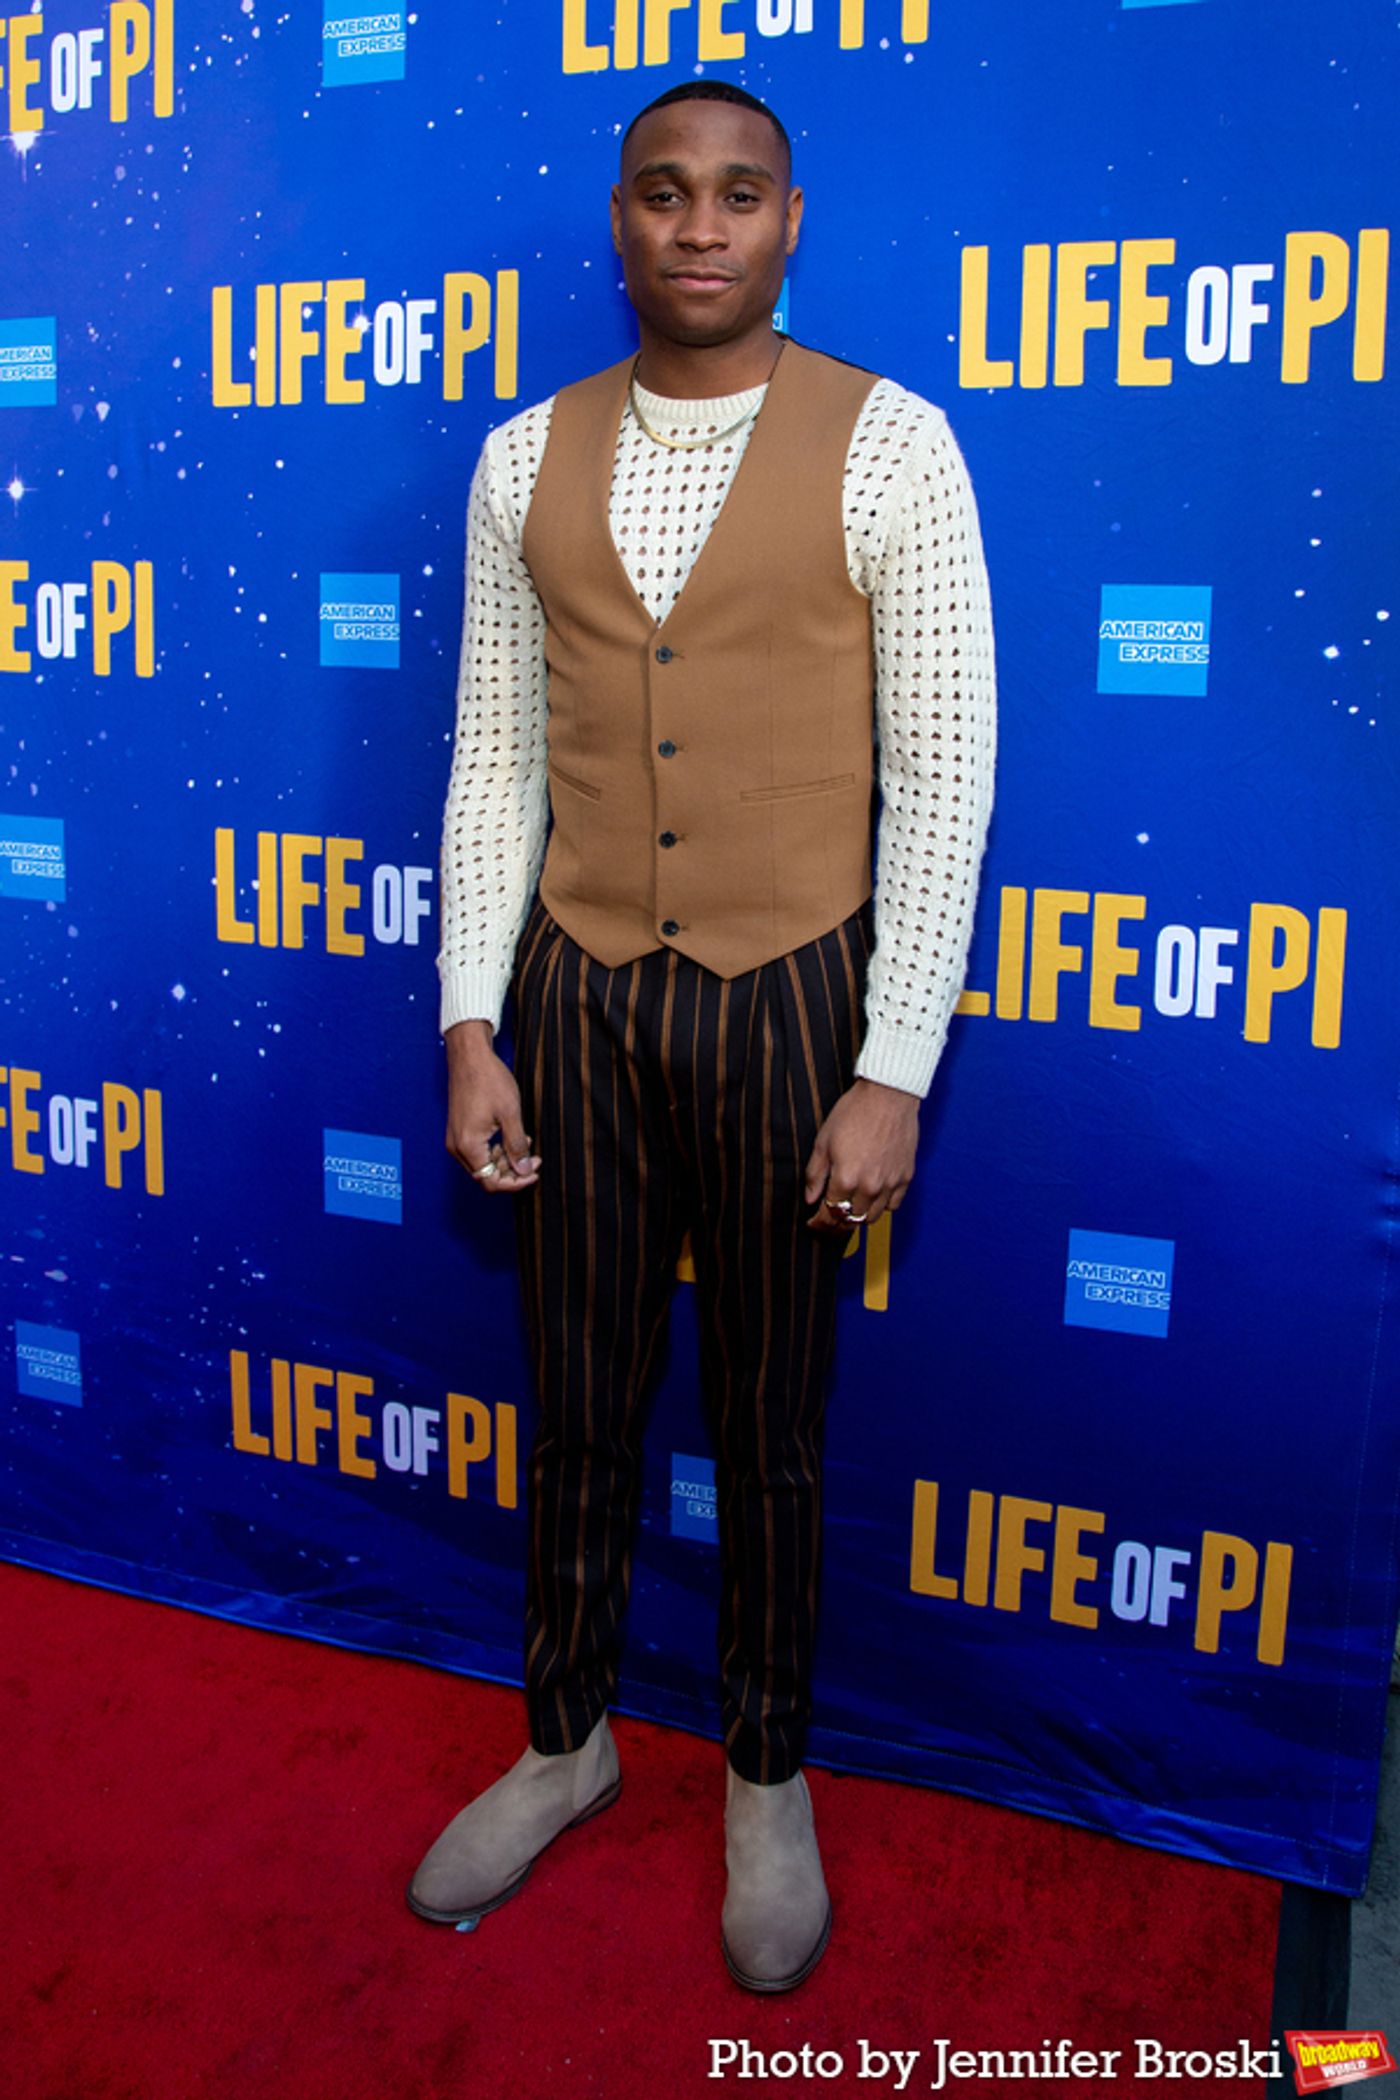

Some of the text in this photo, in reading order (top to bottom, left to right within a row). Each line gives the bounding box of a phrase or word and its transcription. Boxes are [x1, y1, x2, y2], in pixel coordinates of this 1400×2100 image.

[323, 13, 400, 39] AMERICAN
[338, 33, 405, 57] EXPRESS
[51, 28, 104, 113] OF
[110, 0, 174, 122] PI
[960, 229, 1389, 389] LIFE OF PI
[212, 270, 518, 407] LIFE OF PI
[36, 582, 87, 659] OF
[92, 560, 154, 678] PI
[320, 603, 395, 620] AMERICAN
[334, 623, 400, 640] EXPRESS
[1100, 620, 1204, 640] AMERICAN
[1120, 643, 1209, 664] EXPRESS
[215, 828, 433, 956] LIFE OF
[953, 886, 1347, 1049] IFE OF PI
[49, 1095, 98, 1168] OF
[102, 1081, 165, 1197] PI
[324, 1156, 397, 1181] AMERICAN
[338, 1176, 402, 1200] EXPRESS
[1067, 1261, 1166, 1289] AMERICAN
[1085, 1282, 1170, 1310] EXPRESS
[17, 1345, 78, 1369] AMERICAN
[230, 1350, 517, 1510] LIFE OF PI
[909, 1479, 1293, 1666] LIFE OF PI
